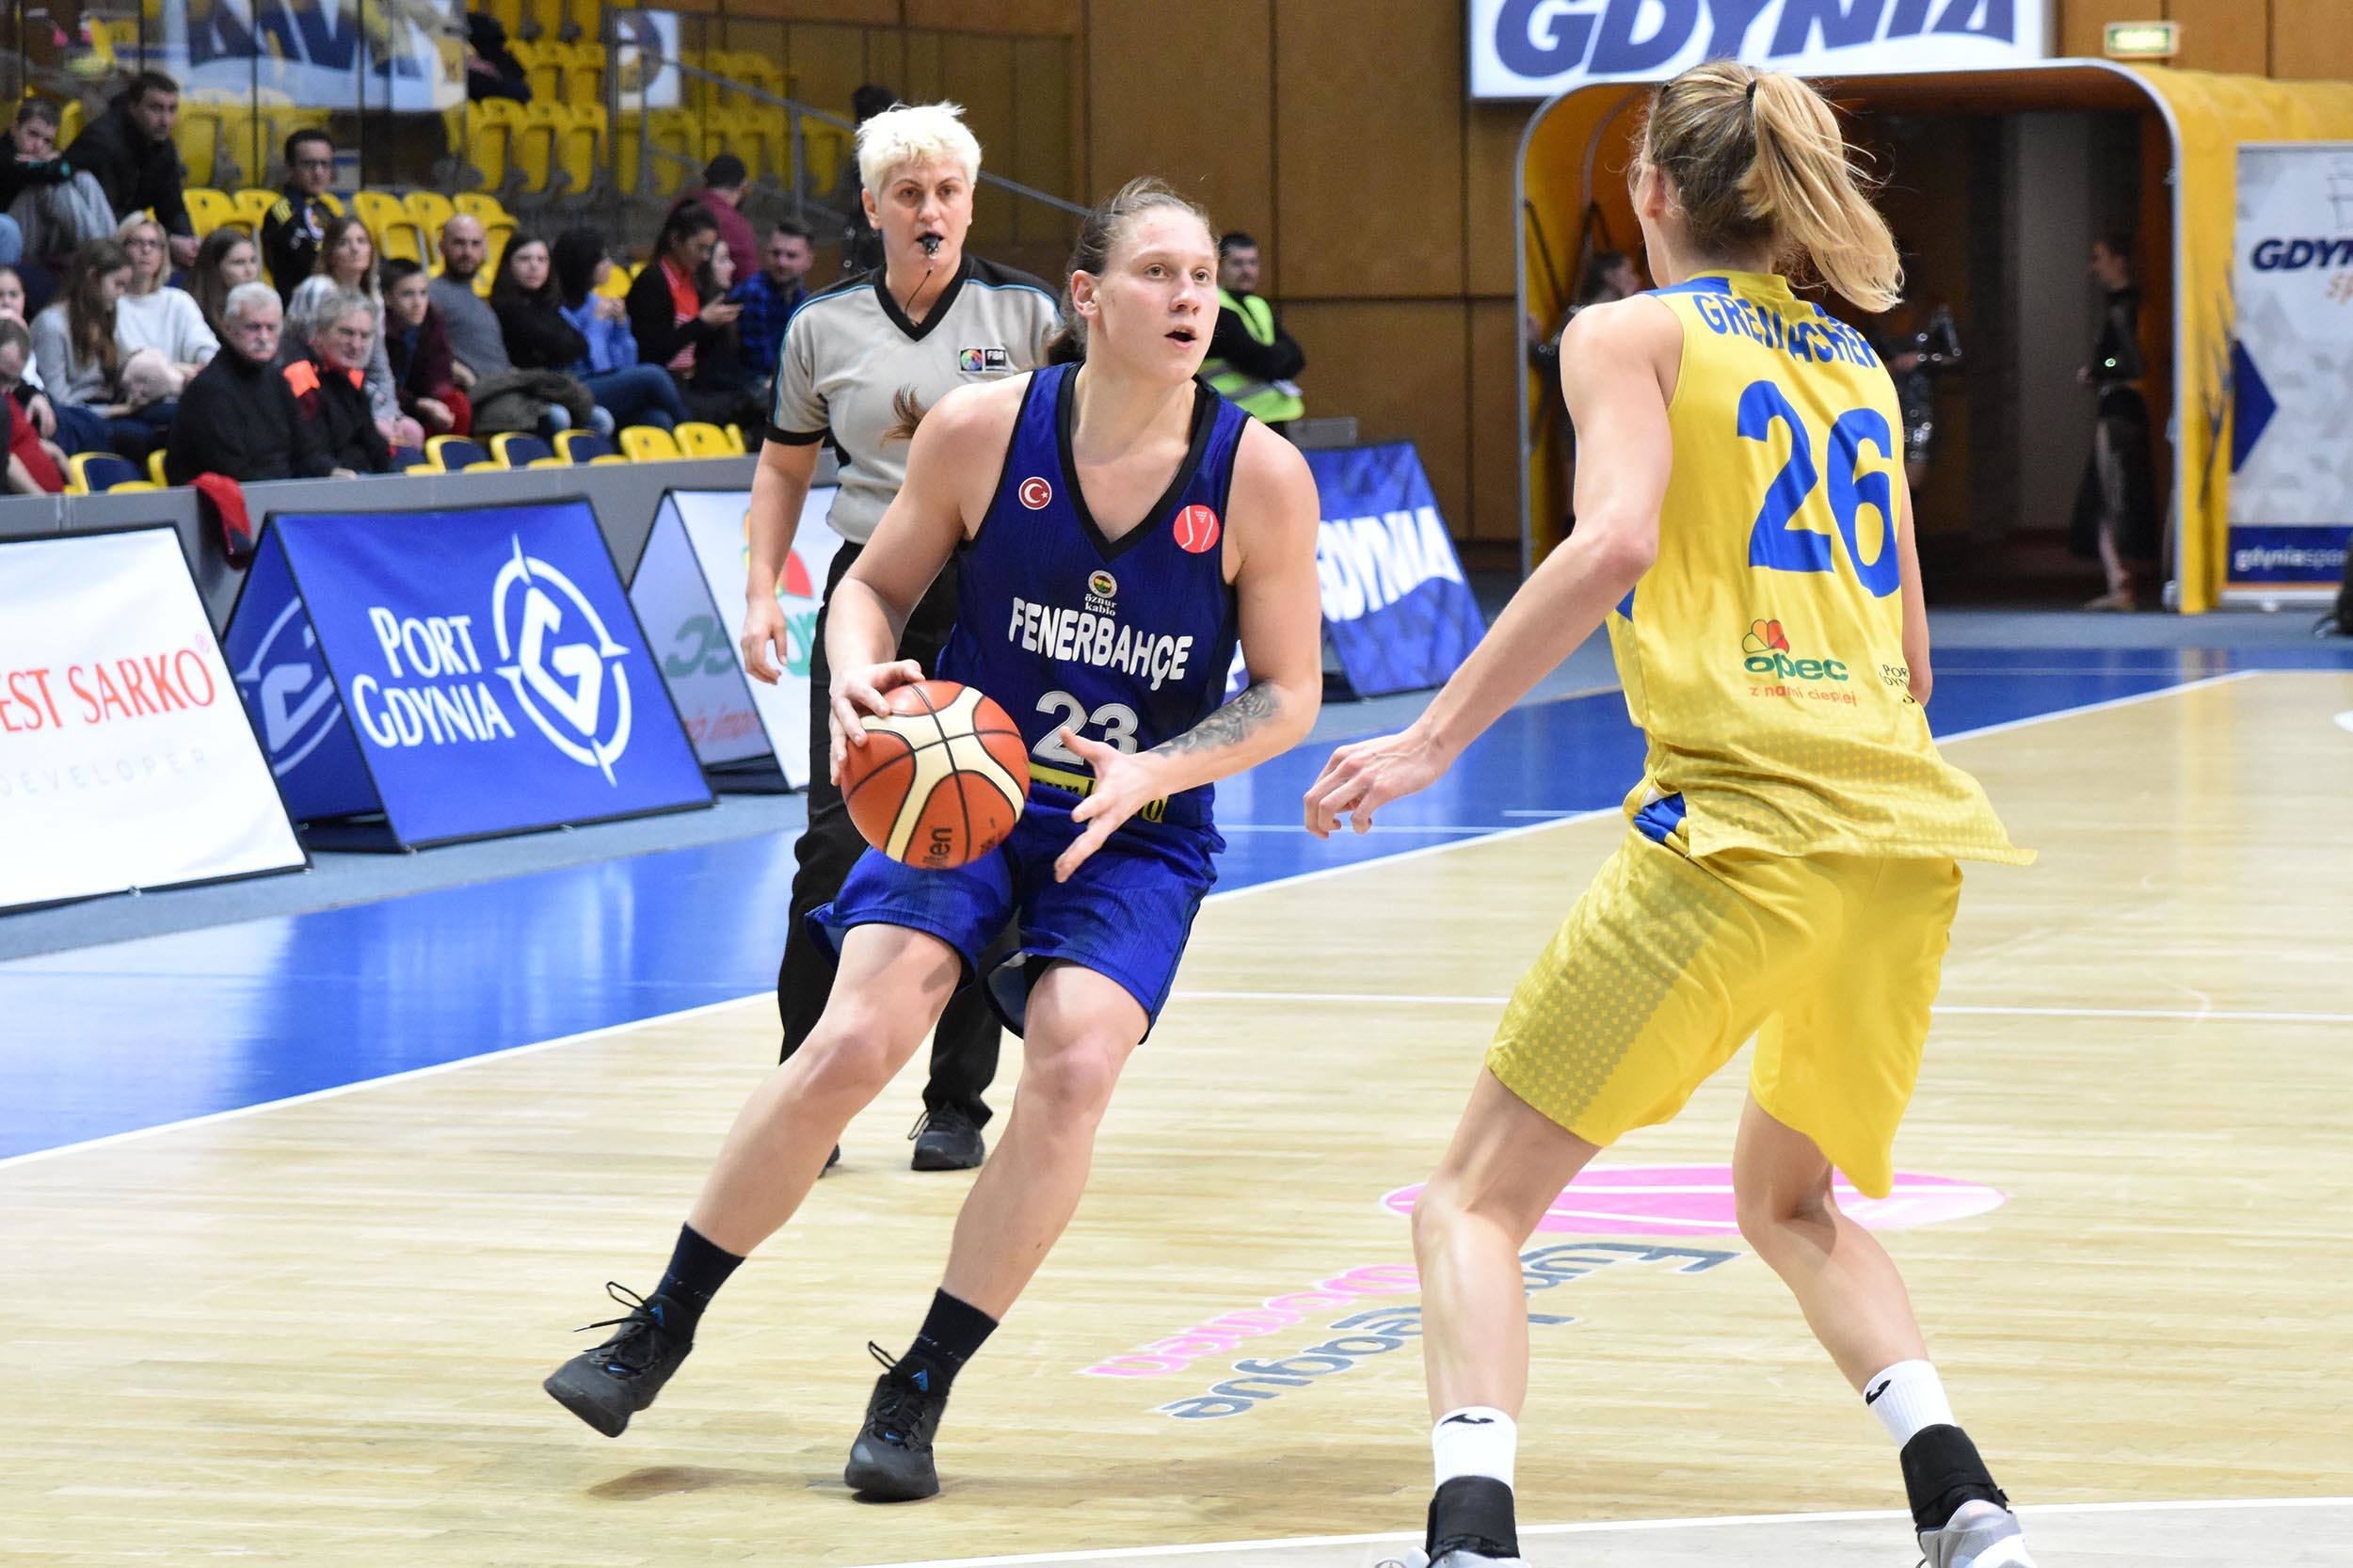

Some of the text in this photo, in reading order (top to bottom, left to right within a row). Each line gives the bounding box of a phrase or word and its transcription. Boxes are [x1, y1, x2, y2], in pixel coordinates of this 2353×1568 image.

[1737, 379, 1901, 599] 26
[1084, 601, 1116, 616] kablo
[1085, 593, 1118, 608] öznur
[1008, 596, 1193, 692] FENERBAHÇE
[1743, 652, 1849, 682] opec
[68, 648, 216, 725] SARKO
[1750, 684, 1859, 708] z nami cieplej
[1032, 690, 1139, 766] 23
